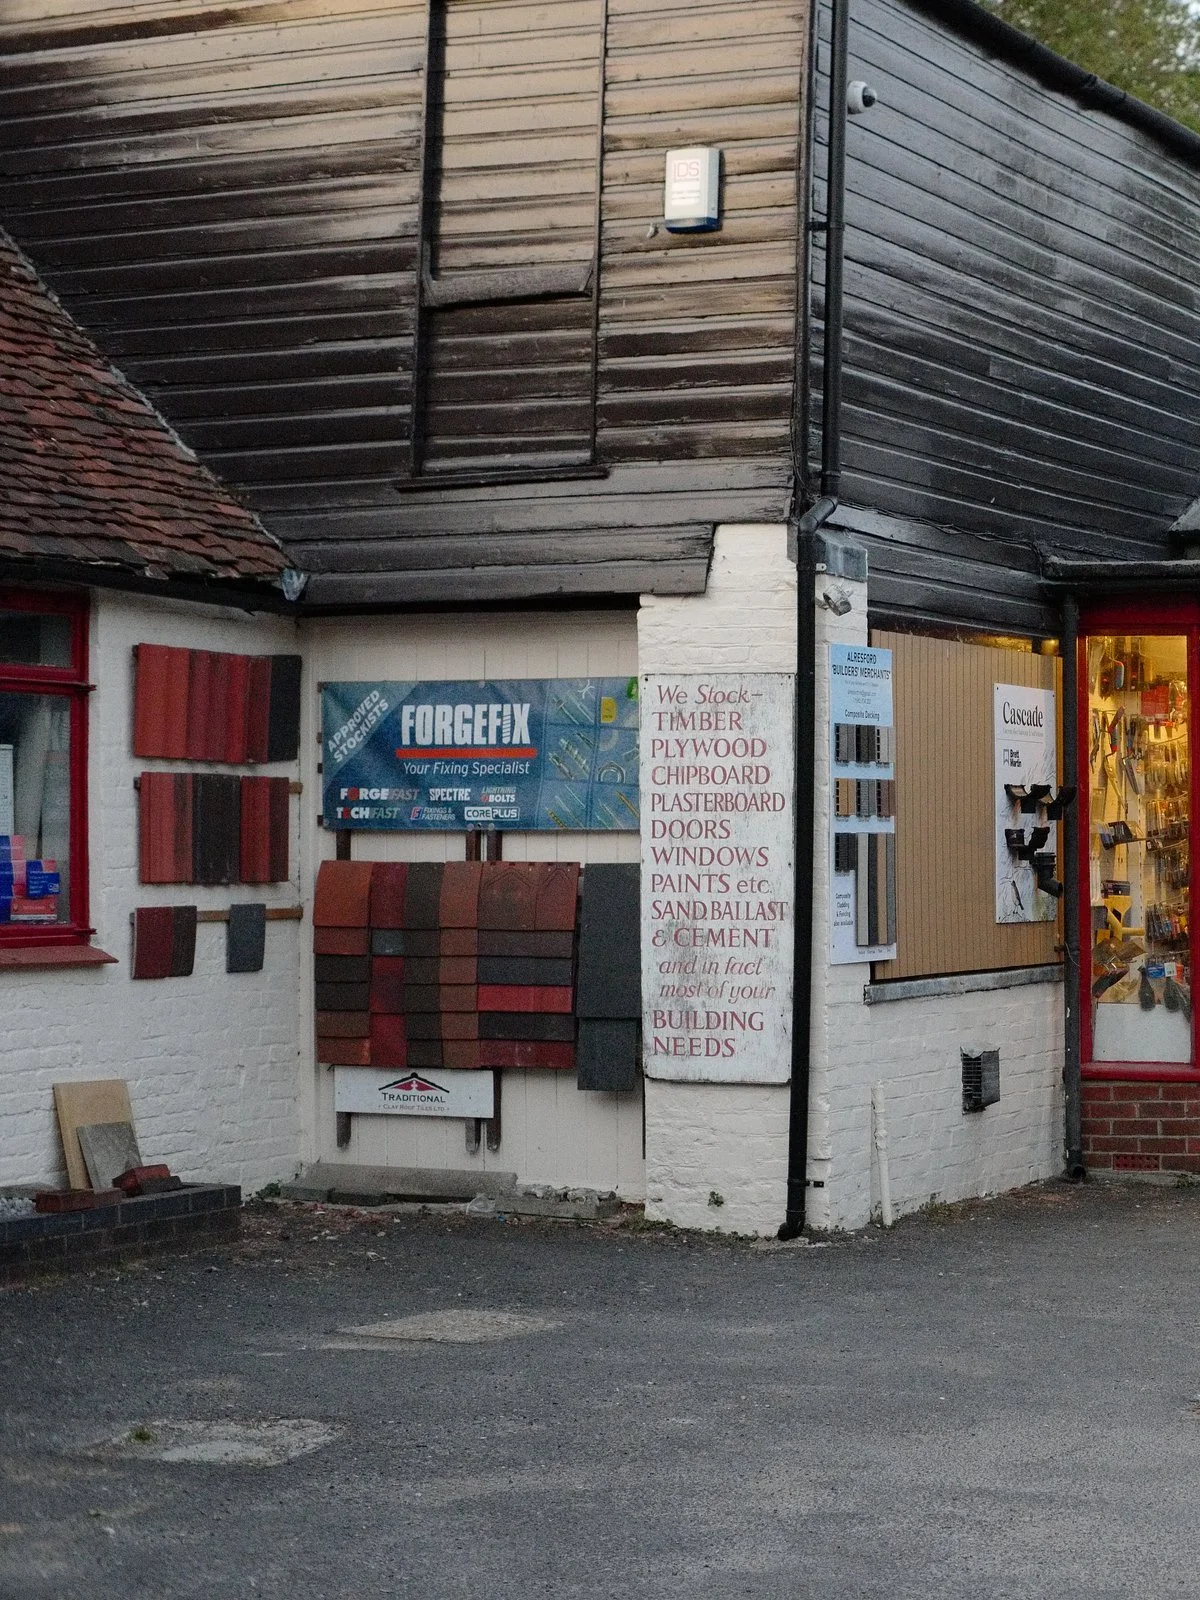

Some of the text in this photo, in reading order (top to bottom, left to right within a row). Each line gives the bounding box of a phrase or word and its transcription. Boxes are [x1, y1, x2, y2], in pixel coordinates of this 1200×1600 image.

[847, 651, 877, 664] ALRESFORD
[657, 685, 688, 705] We
[328, 690, 380, 753] APPROVED
[401, 703, 531, 746] FORGEFIX
[651, 711, 743, 731] TIMBER
[1003, 701, 1044, 728] Cascade
[333, 698, 389, 763] STOCKISTS
[651, 738, 767, 758] PLYWOOD
[403, 761, 531, 777] Your Fixing Specialist
[651, 765, 771, 785] CHIPBOARD
[429, 787, 472, 801] SPECTRE
[488, 794, 516, 803] BOLTS
[651, 792, 786, 812] PLASTERBOARD
[651, 819, 731, 839] DOORS
[650, 846, 769, 867] WINDOWS
[651, 874, 731, 893] PAINTS
[673, 928, 775, 948] CEMENT
[659, 956, 763, 976] and in fact
[659, 980, 776, 1004] most of your
[653, 1009, 765, 1031] BUILDING
[653, 1036, 736, 1058] NEEDS
[382, 1092, 446, 1103] TRADITIONAL
